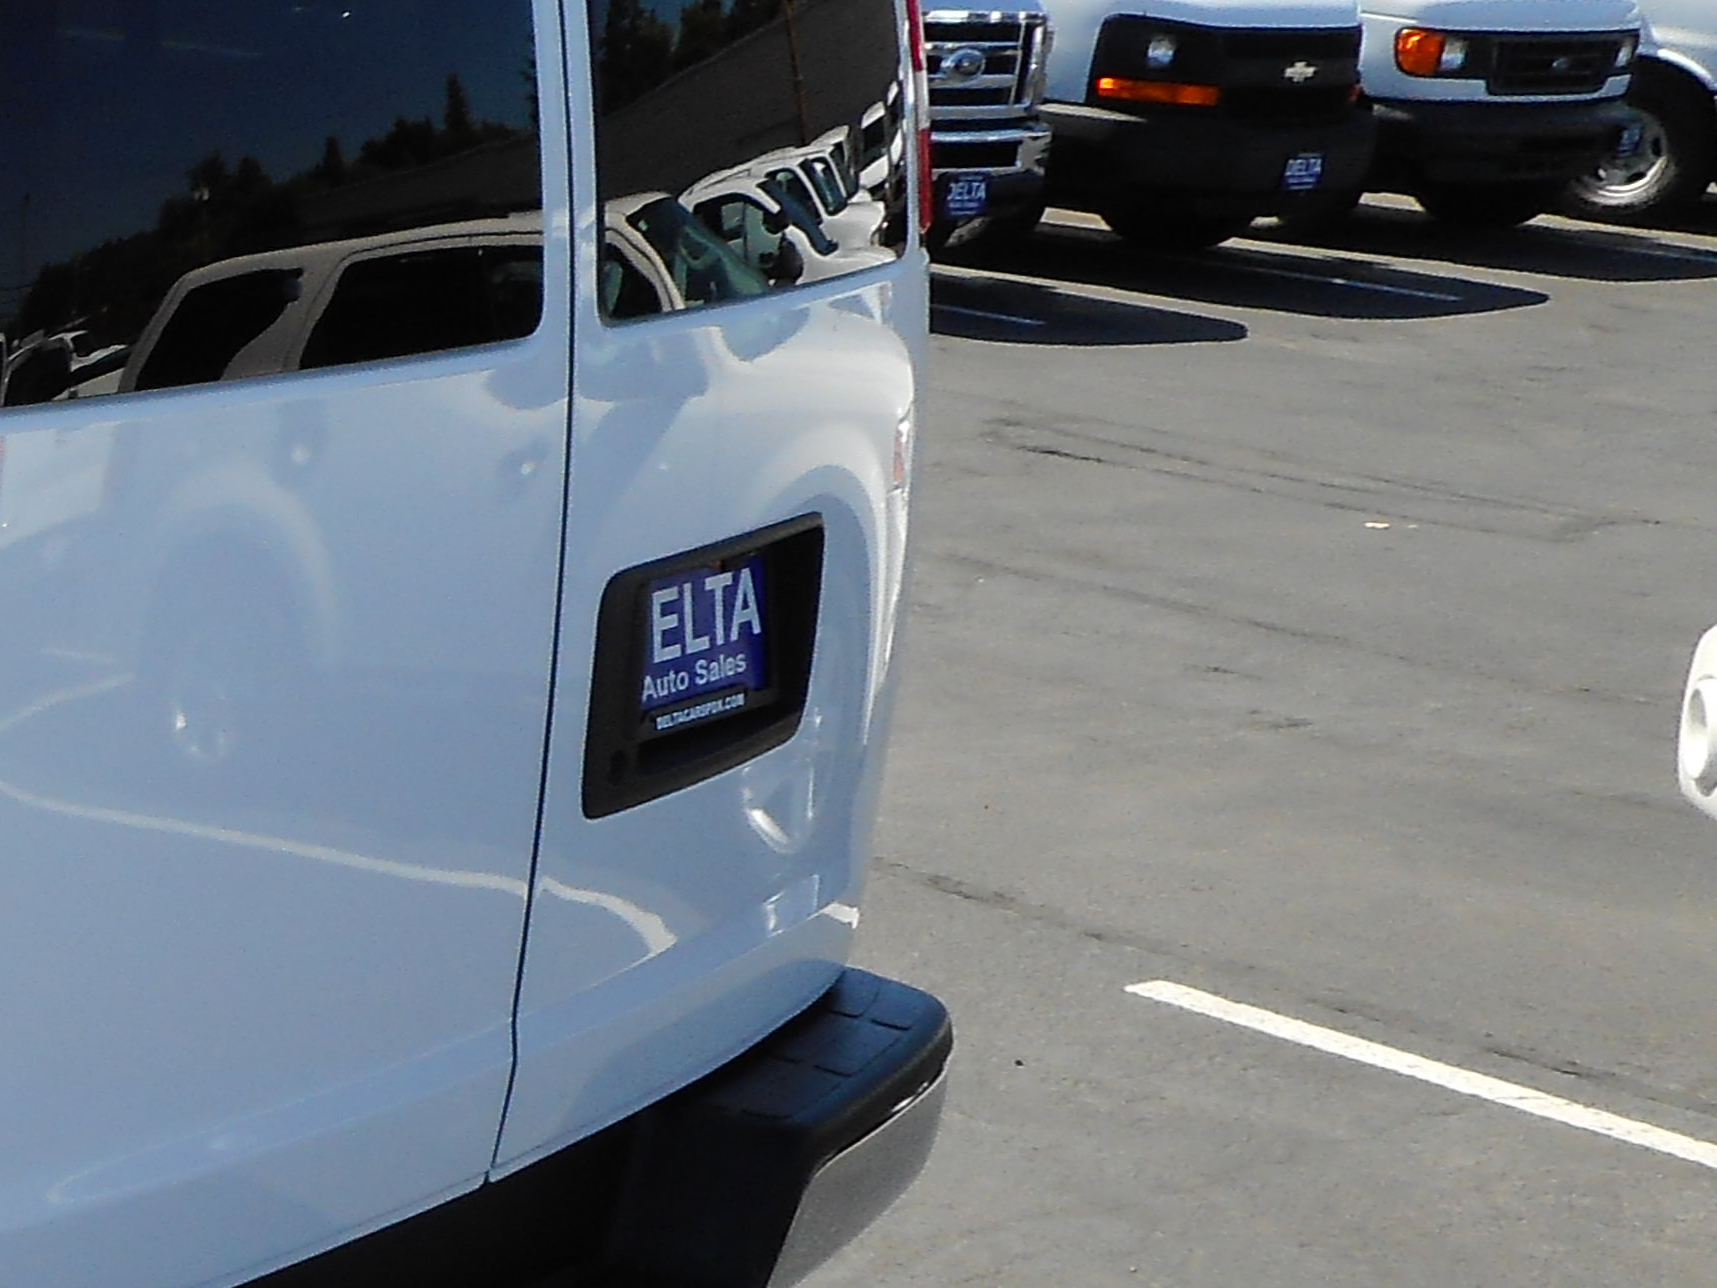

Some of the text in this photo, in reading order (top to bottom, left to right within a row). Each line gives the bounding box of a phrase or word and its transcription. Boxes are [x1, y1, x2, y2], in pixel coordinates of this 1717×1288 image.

[651, 567, 762, 663] ELTA
[641, 652, 747, 702] Auto Sales
